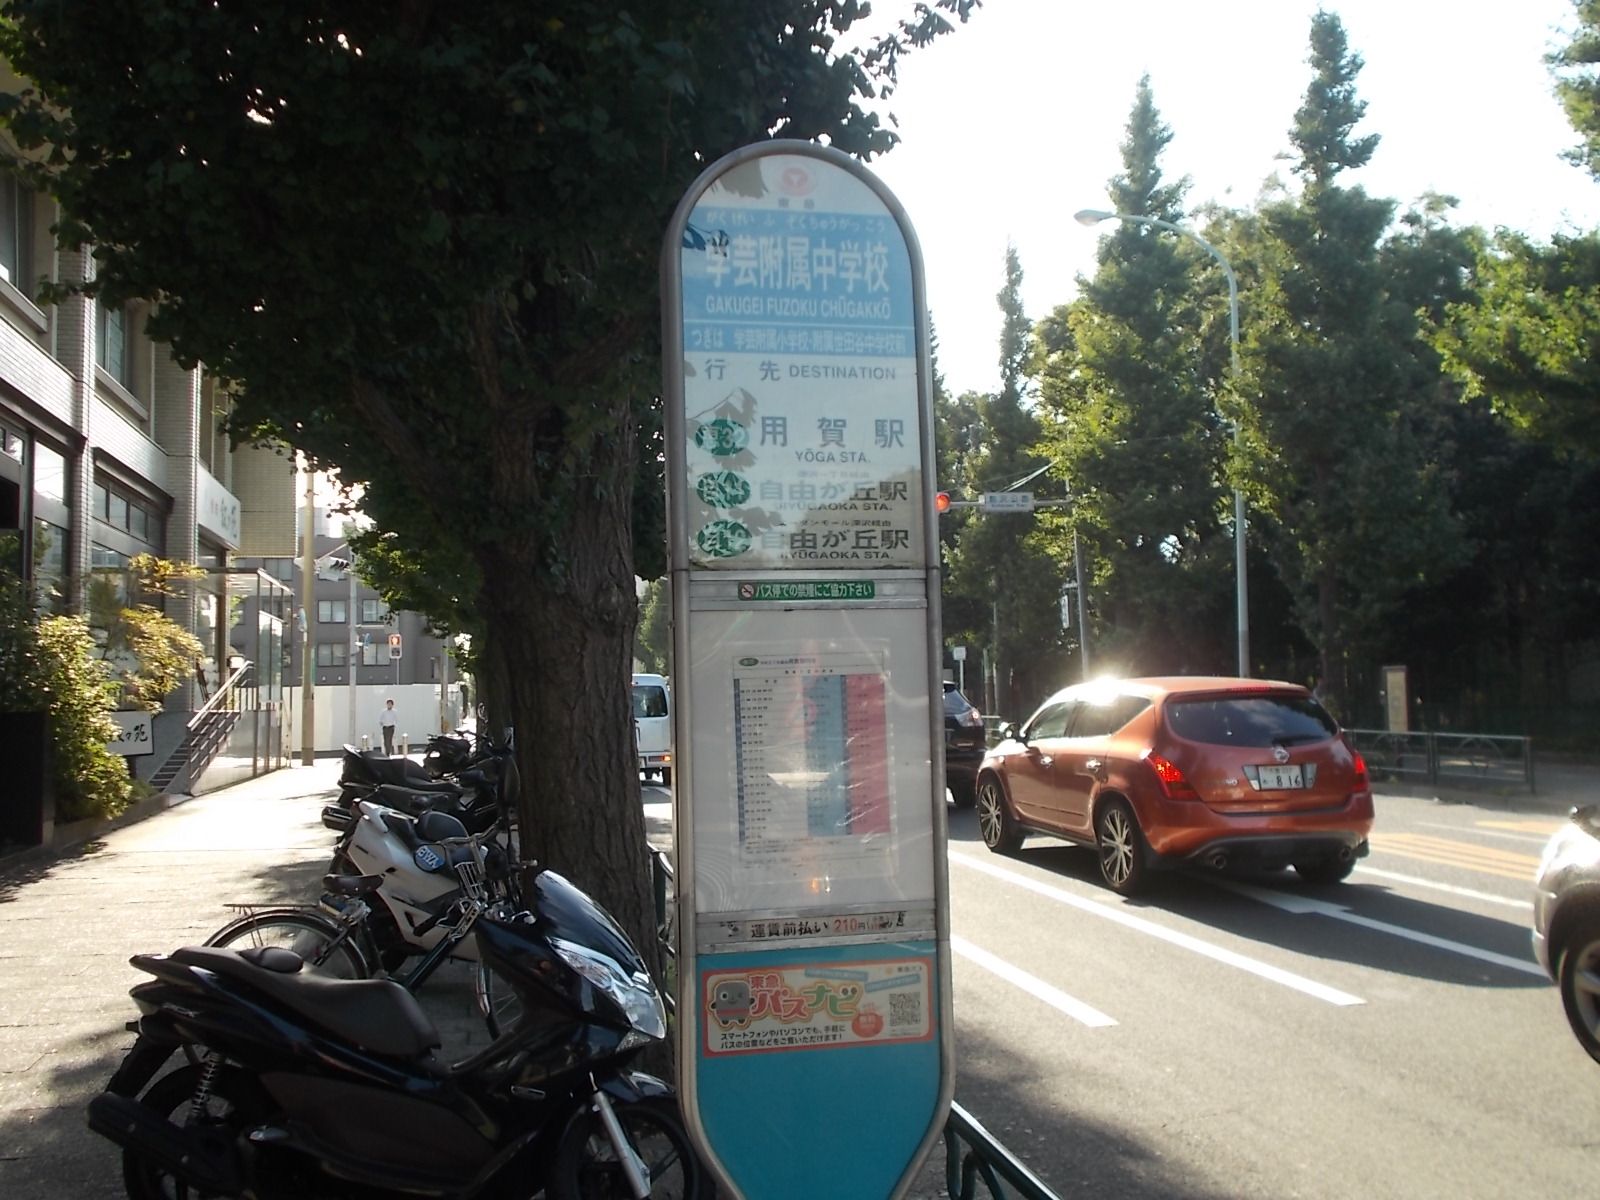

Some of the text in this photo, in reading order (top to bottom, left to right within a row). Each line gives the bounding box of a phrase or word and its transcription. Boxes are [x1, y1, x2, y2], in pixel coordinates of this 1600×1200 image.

[706, 235, 889, 292] 学芸附属中学校
[706, 295, 763, 314] GAKUGEI
[767, 298, 817, 317] FUZOKU
[789, 364, 895, 380] DESTINATION
[839, 450, 871, 463] STA.
[760, 480, 908, 501] 自由が丘駅
[863, 503, 893, 511] STA.
[761, 529, 909, 549] 自由が丘駅
[864, 551, 894, 559] STA.
[751, 974, 782, 989] 東急
